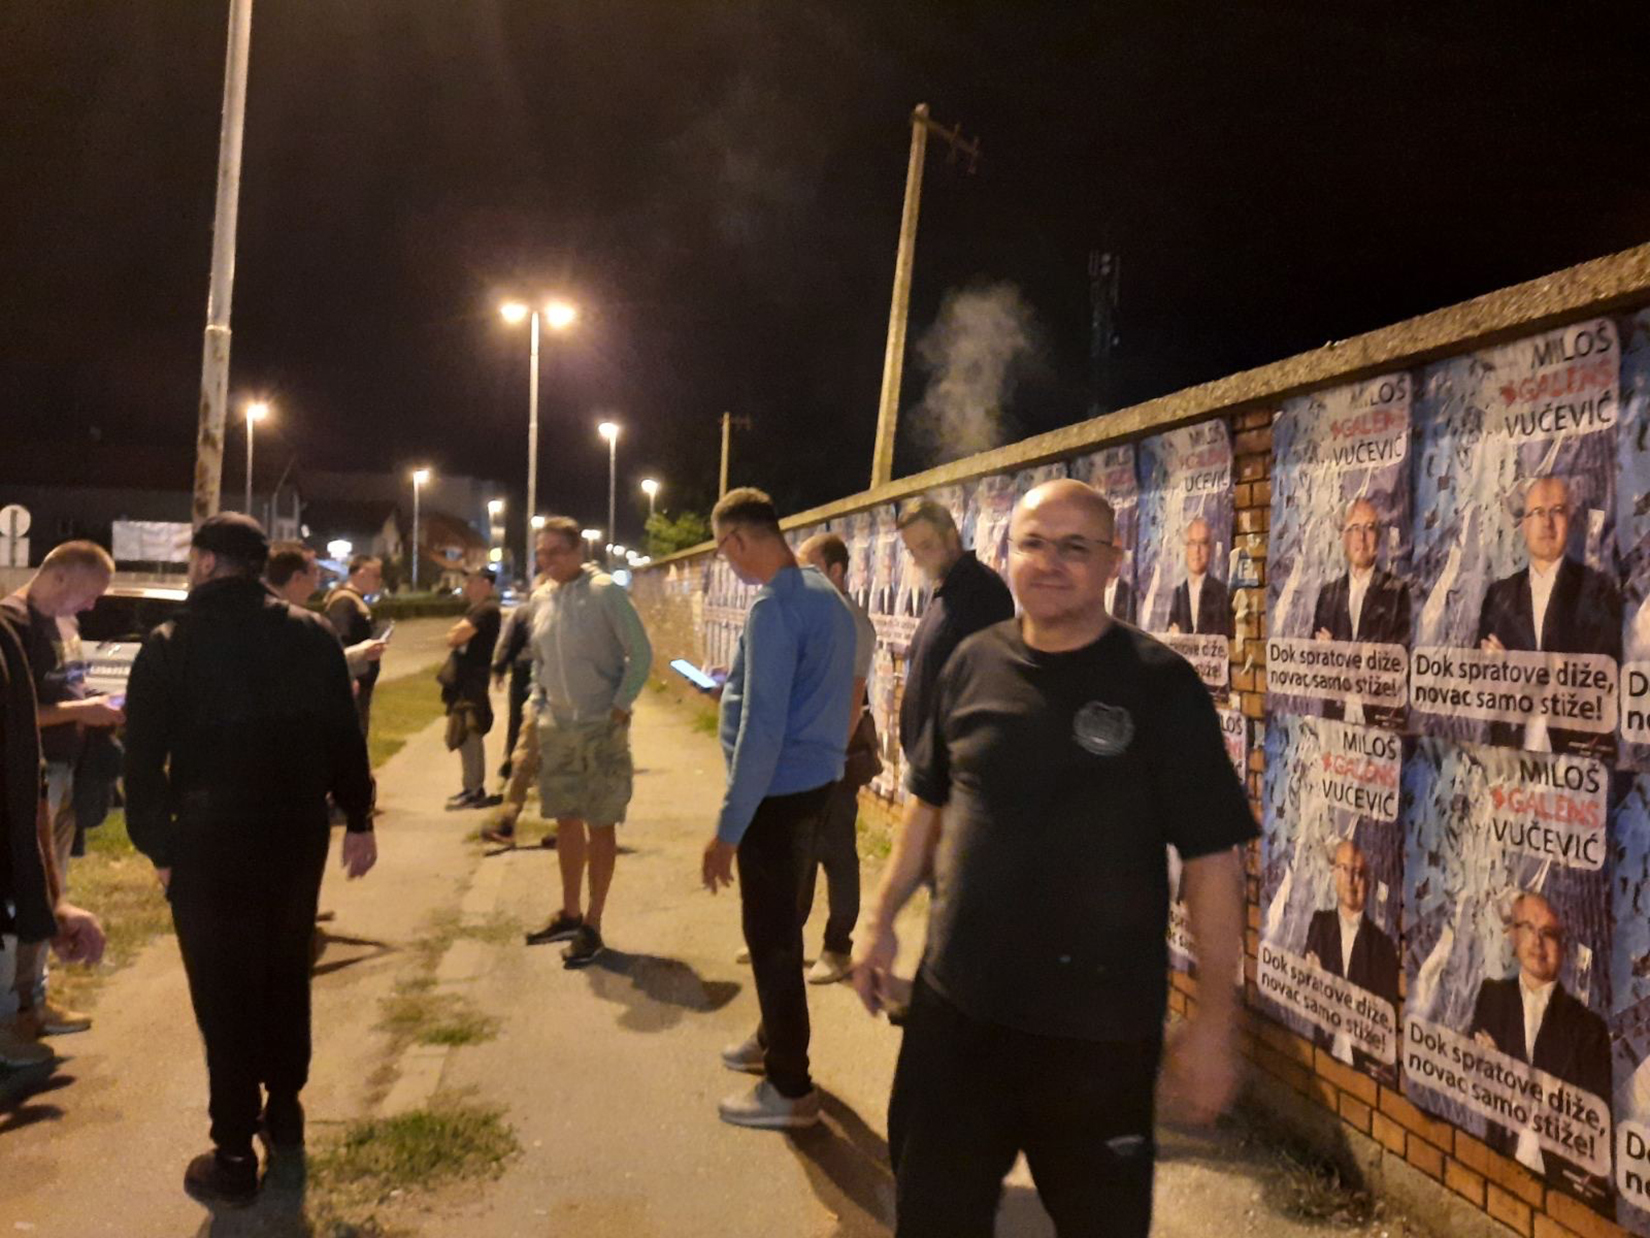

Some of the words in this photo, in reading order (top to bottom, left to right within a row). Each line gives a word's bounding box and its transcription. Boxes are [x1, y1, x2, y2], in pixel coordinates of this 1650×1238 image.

[1530, 321, 1613, 369] MILOŠ
[1504, 390, 1611, 438] VUČEVIĆ
[1270, 644, 1297, 663] Dok
[1300, 649, 1362, 669] spratove
[1366, 649, 1405, 673] diže,
[1416, 654, 1453, 677] Dok
[1458, 659, 1550, 686] spratove
[1556, 661, 1614, 694] diže,
[1270, 670, 1310, 687] novac
[1312, 675, 1353, 692] samo
[1355, 675, 1398, 697] stiže!
[1415, 685, 1472, 706] novac
[1476, 692, 1534, 714] samo
[1540, 694, 1603, 721] stiže!
[1519, 758, 1600, 793] MILOŠ
[1507, 786, 1600, 829] GALENS
[1492, 817, 1599, 865] VUČEVIĆ
[1262, 947, 1288, 974] Dok
[1261, 972, 1301, 1004] novac
[1303, 996, 1341, 1027] samo
[1409, 1022, 1448, 1056] Dok
[1452, 1046, 1544, 1101] spratove
[1550, 1086, 1607, 1138] diže,
[1408, 1053, 1469, 1095] novac
[1471, 1082, 1528, 1124] samo
[1532, 1110, 1596, 1162] stiže!
